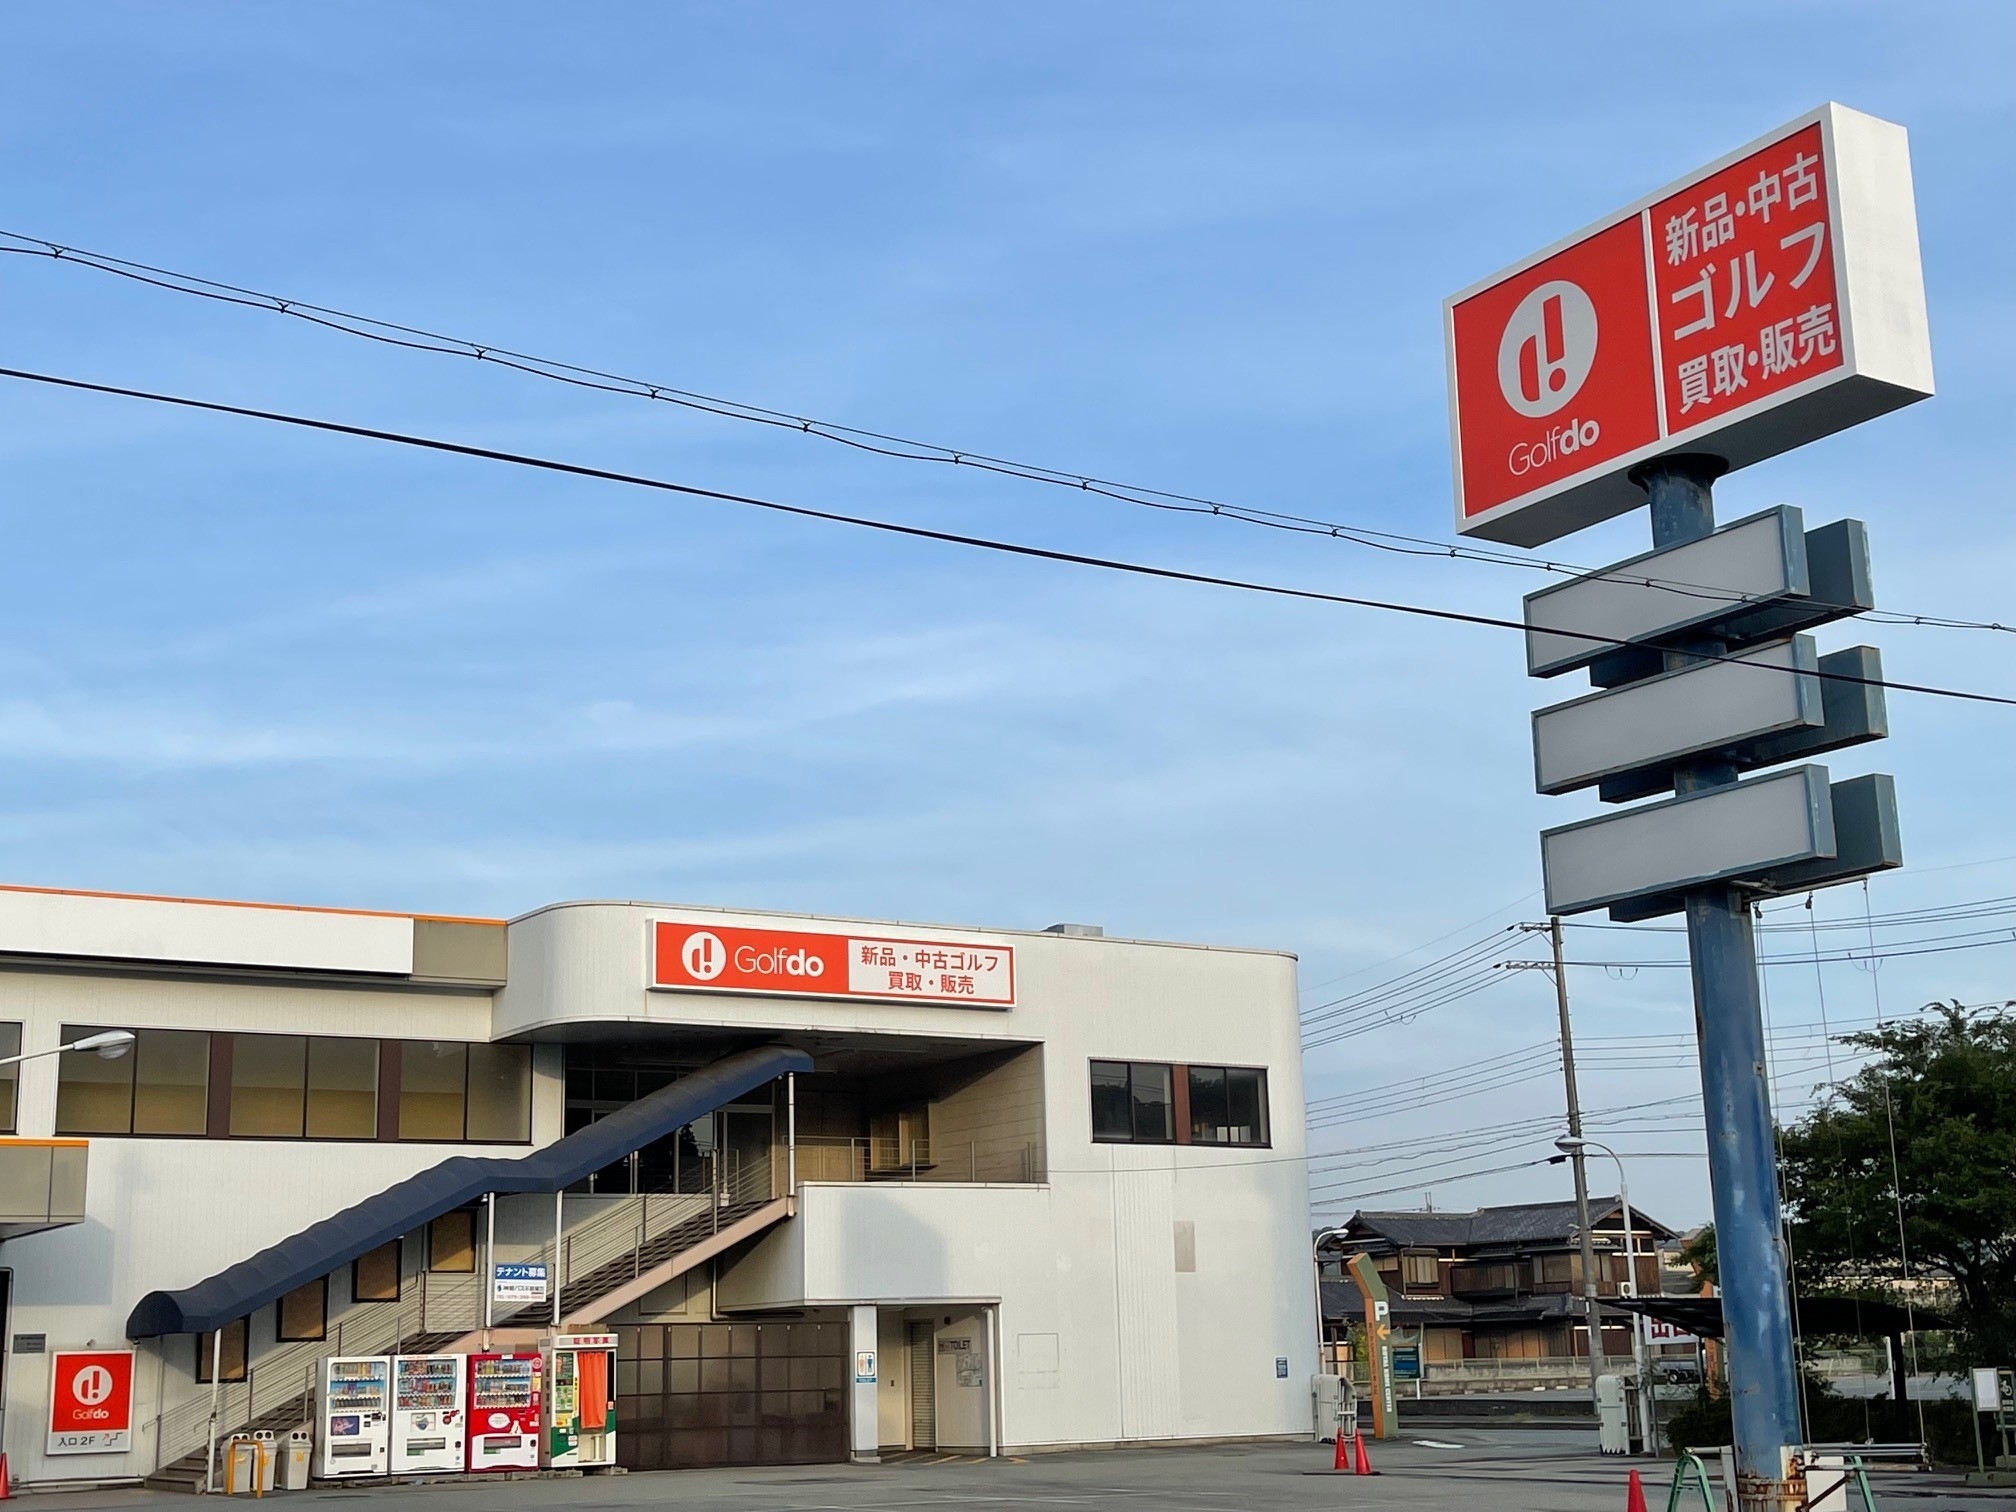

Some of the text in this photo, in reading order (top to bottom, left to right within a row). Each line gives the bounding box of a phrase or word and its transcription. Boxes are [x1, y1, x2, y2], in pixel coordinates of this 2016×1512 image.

[1665, 152, 1819, 266] 新品・中古
[1673, 222, 1826, 341] ゴルフ
[1678, 303, 1837, 415] 買取・販売
[1509, 418, 1600, 476] Golfdo
[734, 945, 825, 978] Golfdo
[861, 945, 999, 972] 新品・中古ゴルフ
[888, 970, 975, 995] 買取・販売
[1374, 1301, 1389, 1321] P
[73, 1408, 110, 1420] Golfdo
